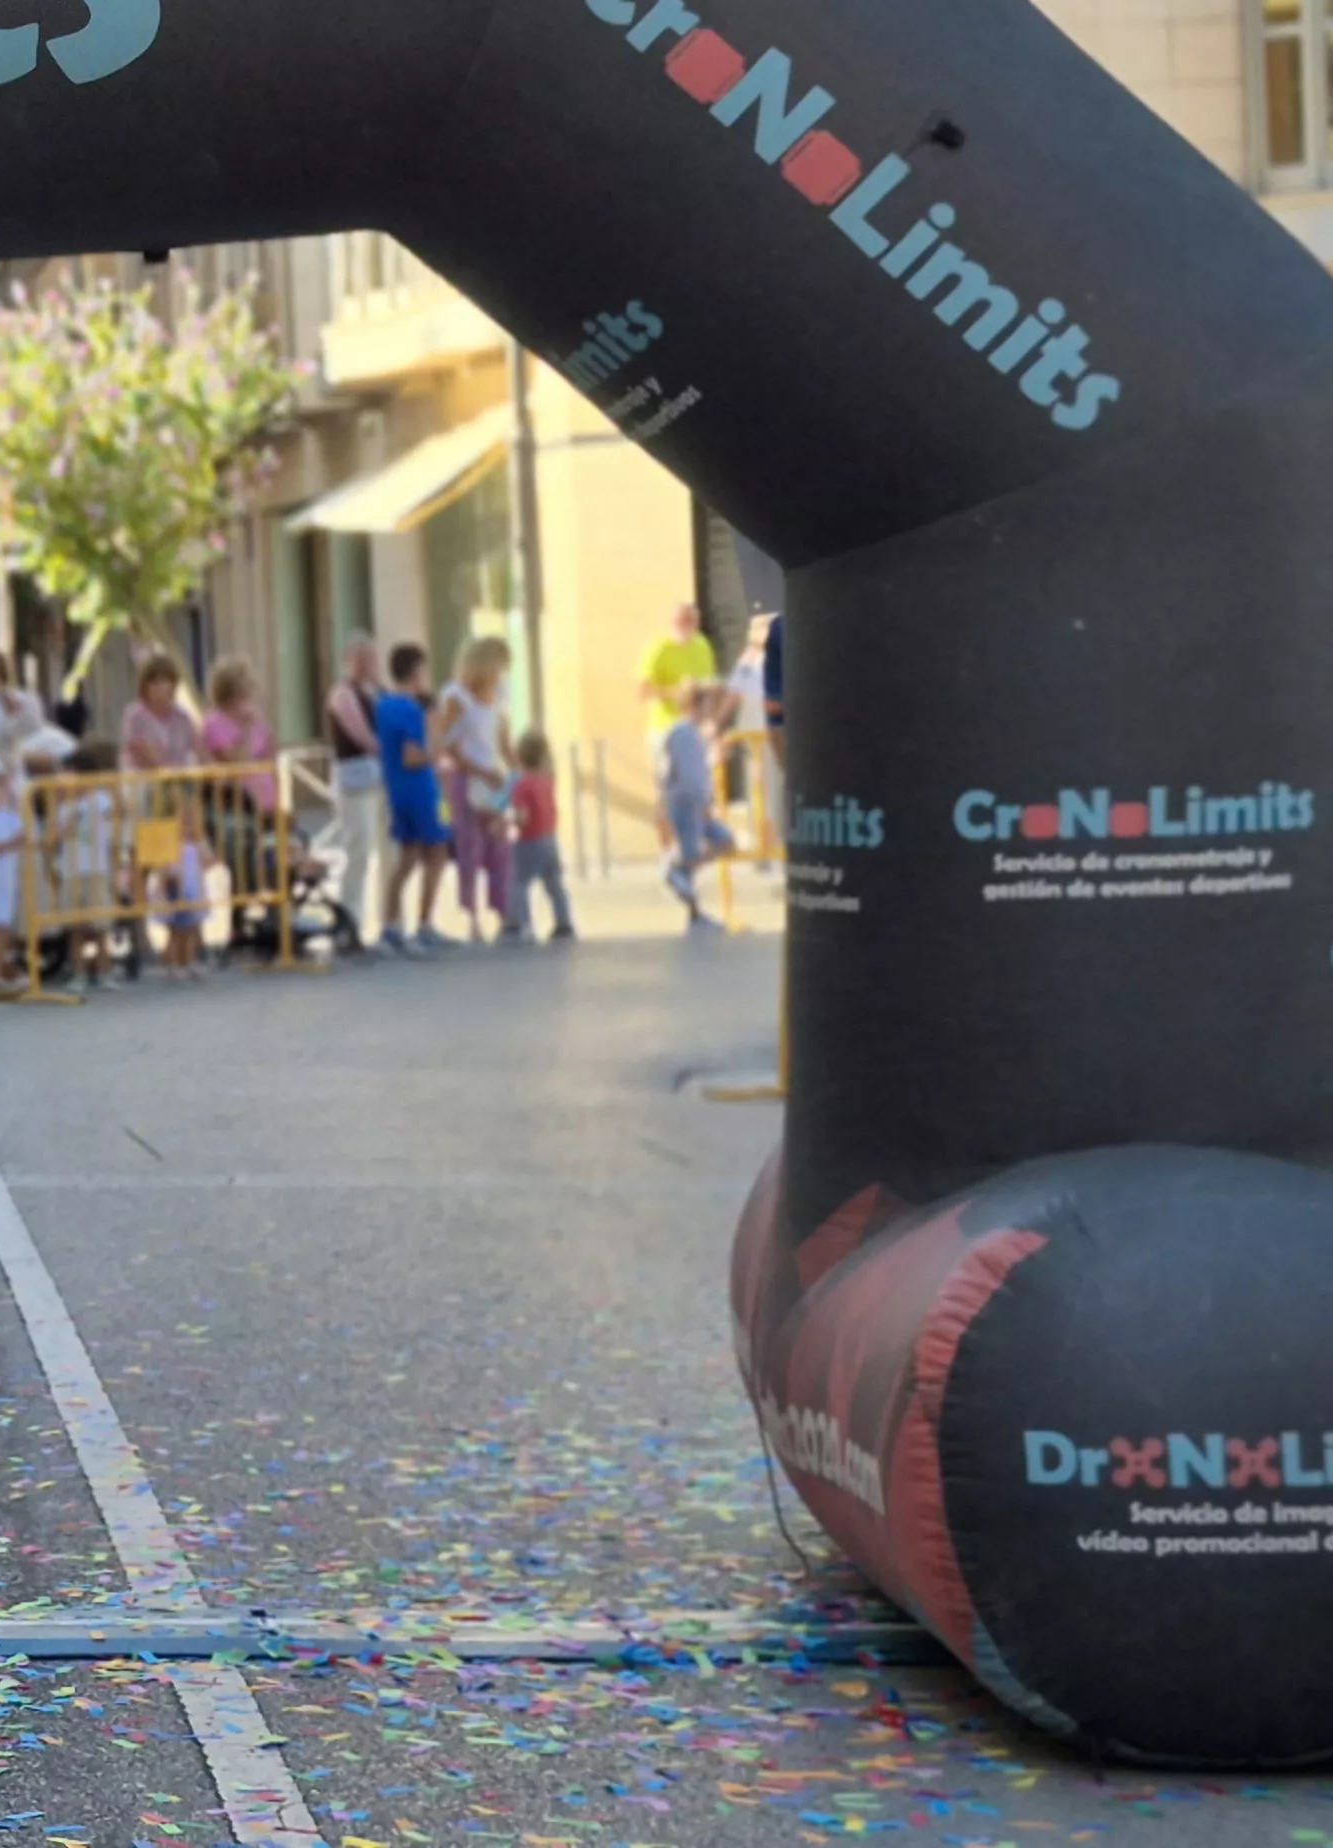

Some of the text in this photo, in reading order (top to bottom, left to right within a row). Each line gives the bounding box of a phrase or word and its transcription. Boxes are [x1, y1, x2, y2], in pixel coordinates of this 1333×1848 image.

[993, 847, 1273, 872] Servicio de cronometraje y
[983, 871, 1292, 901] gestión de eventos deportivos
[1129, 1502, 1229, 1524] Servicio
[1233, 1501, 1268, 1524] de
[1077, 1529, 1149, 1553] vídeo
[1154, 1530, 1319, 1557] promocional
